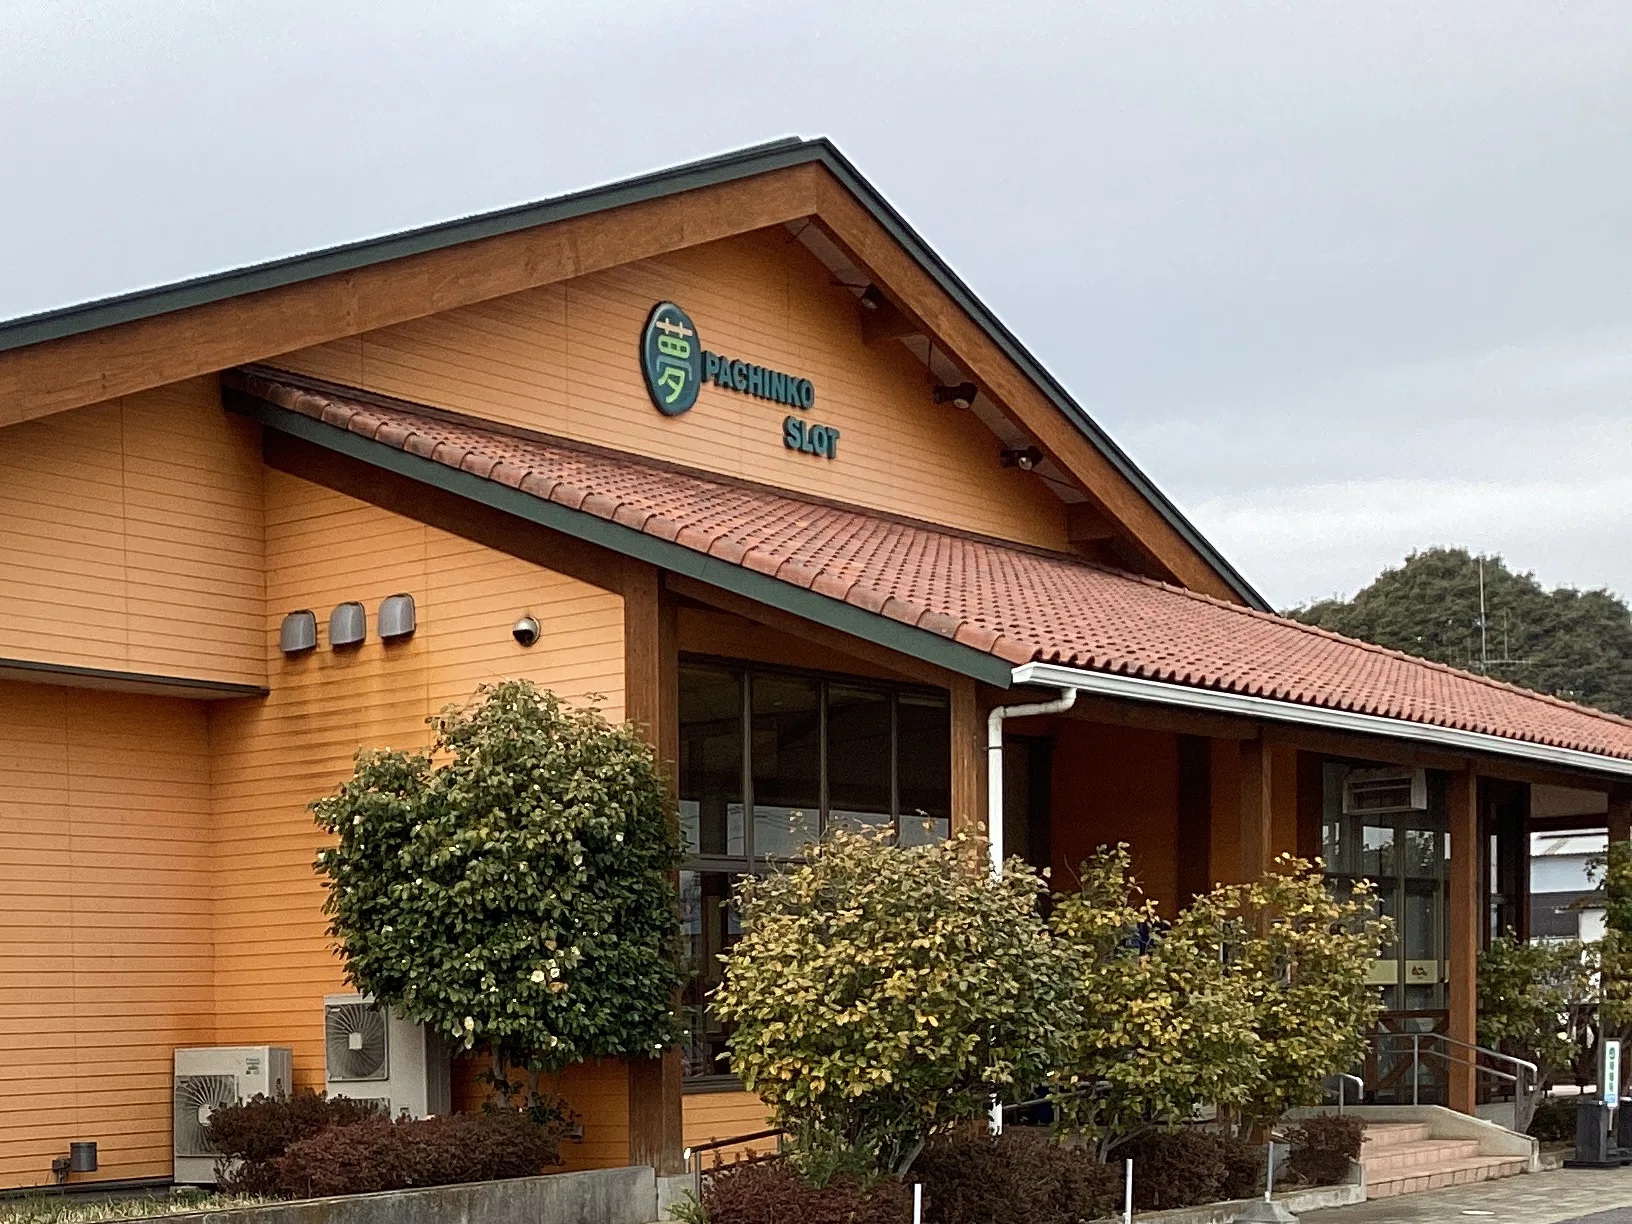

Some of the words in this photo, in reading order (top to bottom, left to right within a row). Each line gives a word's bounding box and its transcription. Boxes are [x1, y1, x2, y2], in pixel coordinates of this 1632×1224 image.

[655, 317, 693, 404] 夢
[701, 350, 815, 410] PACHINKO
[783, 415, 840, 460] SLOT
